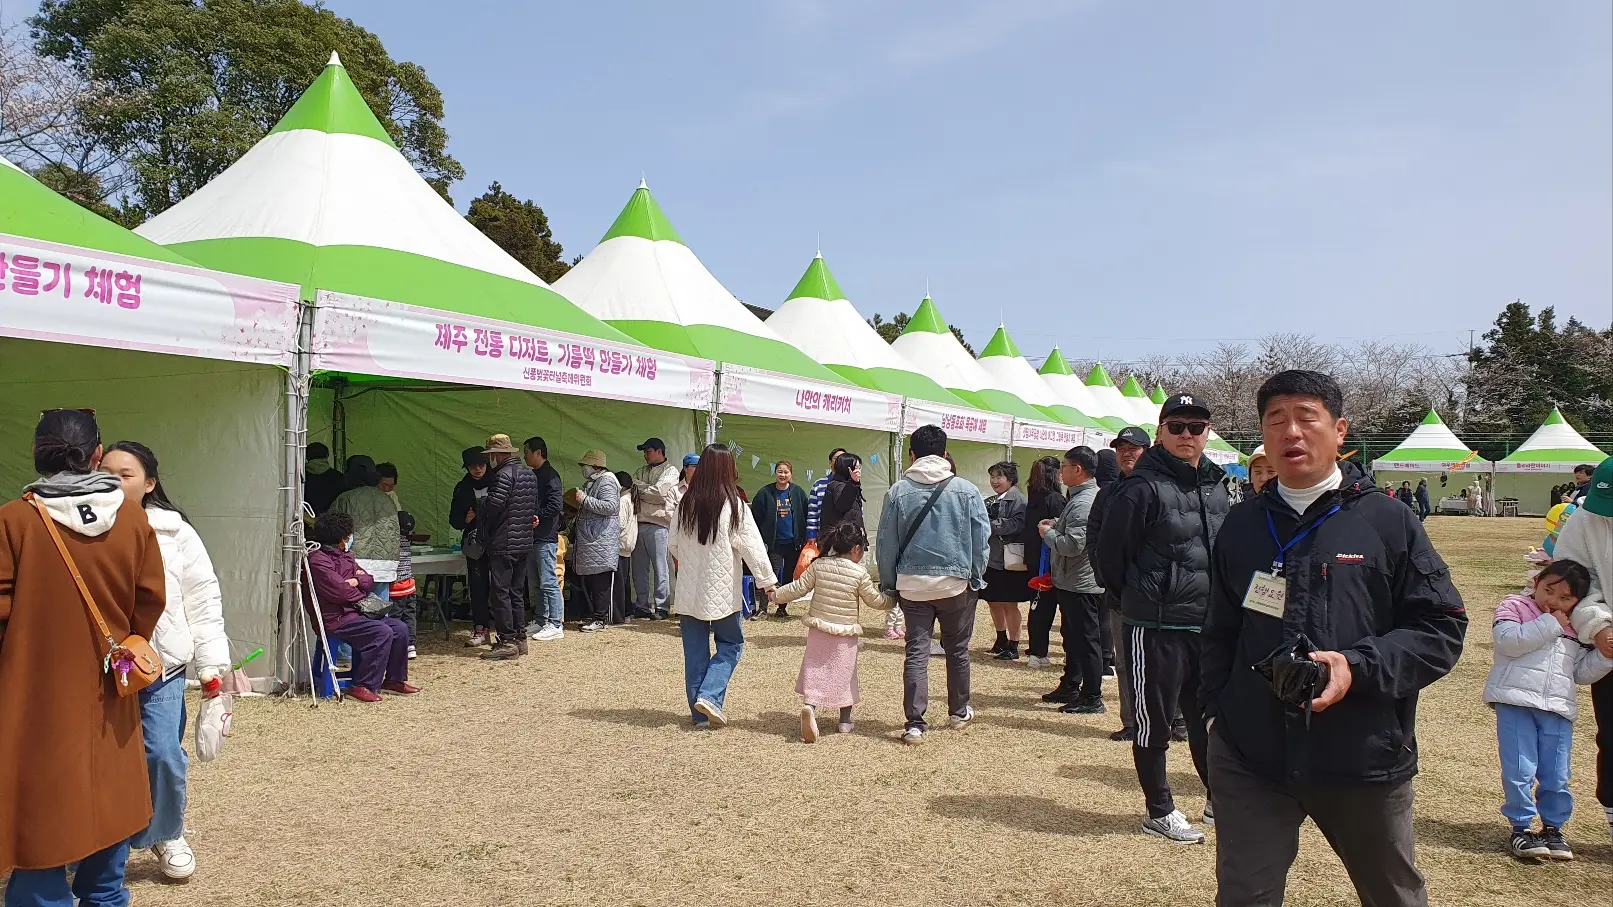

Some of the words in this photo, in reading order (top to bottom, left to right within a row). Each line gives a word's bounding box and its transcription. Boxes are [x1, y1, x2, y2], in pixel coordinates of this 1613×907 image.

[0, 252, 72, 299] 들기
[84, 266, 142, 310] 체험
[435, 324, 468, 353] 제주
[473, 328, 504, 359] 전통
[509, 335, 552, 367] 디저트,
[557, 343, 595, 372] 기름떡
[598, 349, 633, 377] 만들기
[636, 355, 657, 381] 체험
[523, 366, 592, 387] 신풍벚꽃터널축제위원회
[796, 389, 822, 411] 나만의
[1180, 395, 1193, 405] NY
[77, 504, 98, 525] B
